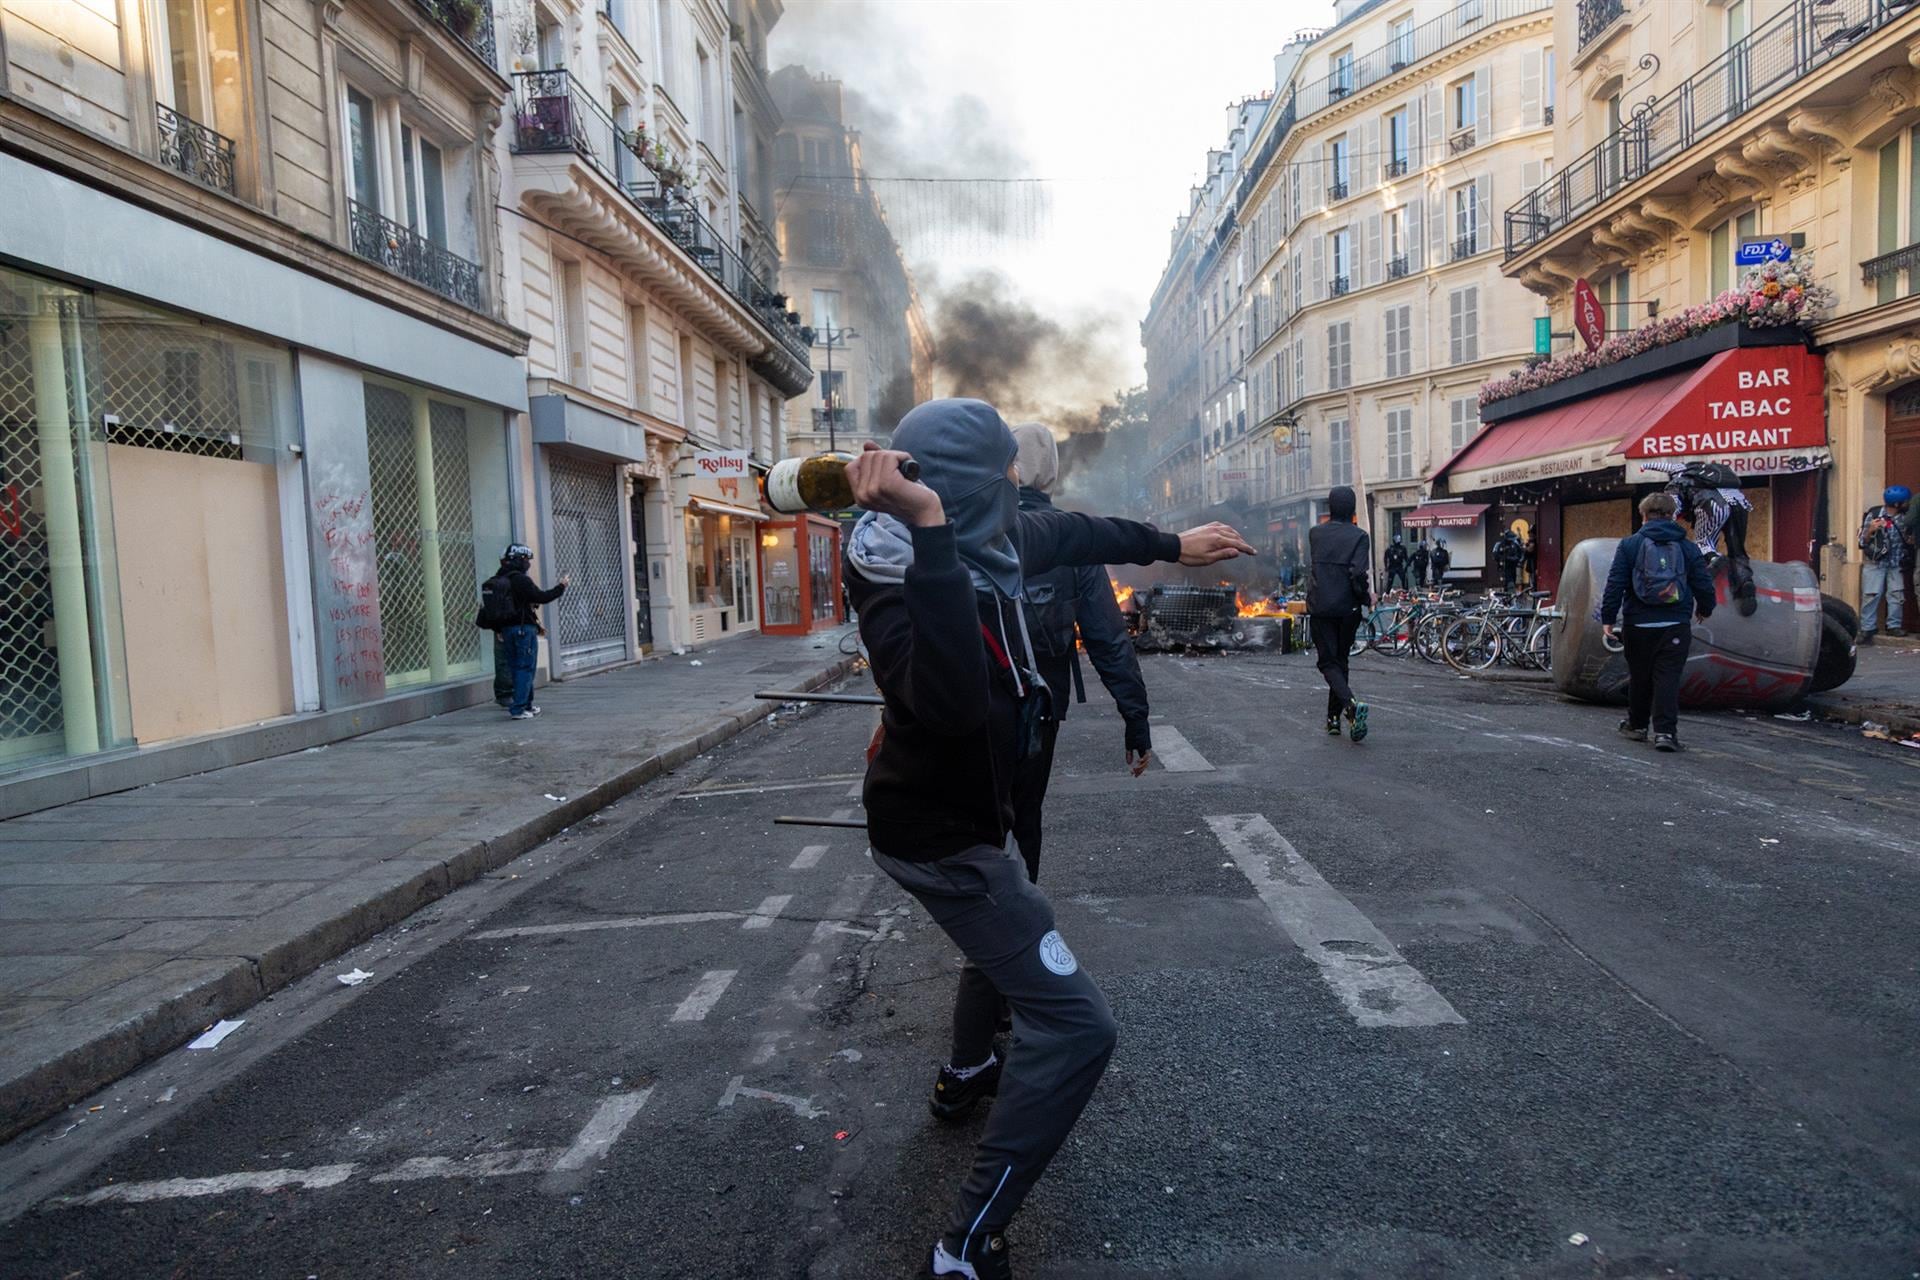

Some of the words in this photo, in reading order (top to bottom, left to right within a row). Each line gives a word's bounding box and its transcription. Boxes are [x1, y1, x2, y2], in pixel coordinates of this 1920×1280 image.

[1744, 245, 1766, 255] FDJ
[1580, 289, 1601, 346] TABAC
[1738, 368, 1791, 389] BAR
[1708, 398, 1792, 420] TABAC
[1643, 427, 1793, 455] RESTAURANT
[698, 456, 743, 473] Rollsy
[1492, 474, 1500, 483] LA
[1501, 467, 1529, 482] BARRIQUE
[1541, 457, 1583, 475] RESTAURANT
[1403, 519, 1432, 528] TRAITEUR
[1438, 517, 1472, 526] ASIATIQUE
